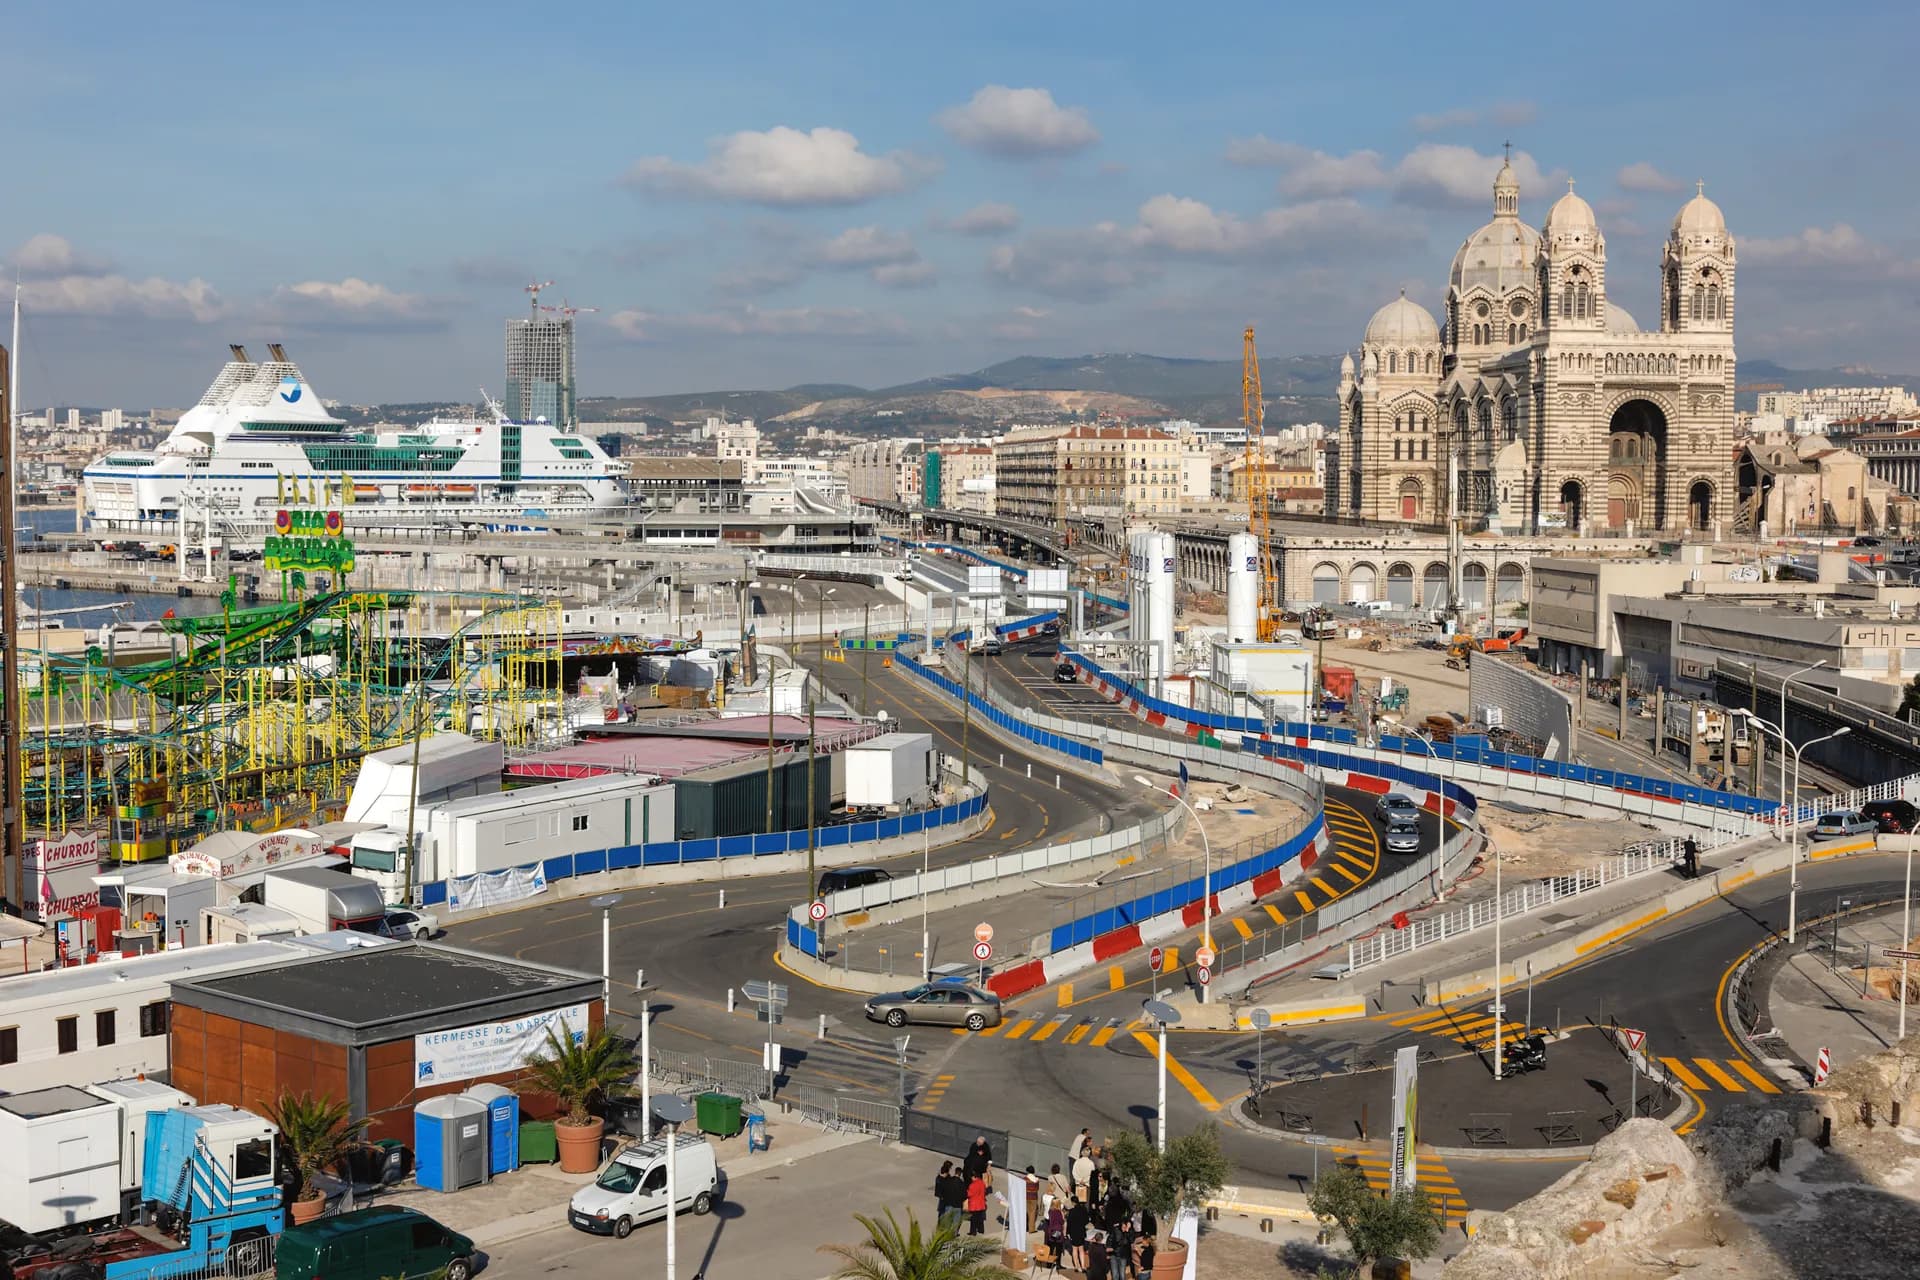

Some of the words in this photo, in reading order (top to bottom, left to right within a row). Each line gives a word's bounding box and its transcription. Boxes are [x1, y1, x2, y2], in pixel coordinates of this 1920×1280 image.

[291, 510, 325, 536] RIO
[46, 839, 96, 862] CHURROS
[258, 834, 289, 851] WINNER
[178, 851, 209, 863] WINNER
[46, 891, 99, 916] CHURROS
[1151, 955, 1161, 964] STOP
[425, 1027, 489, 1045] KERMESSE
[496, 1025, 511, 1035] DE
